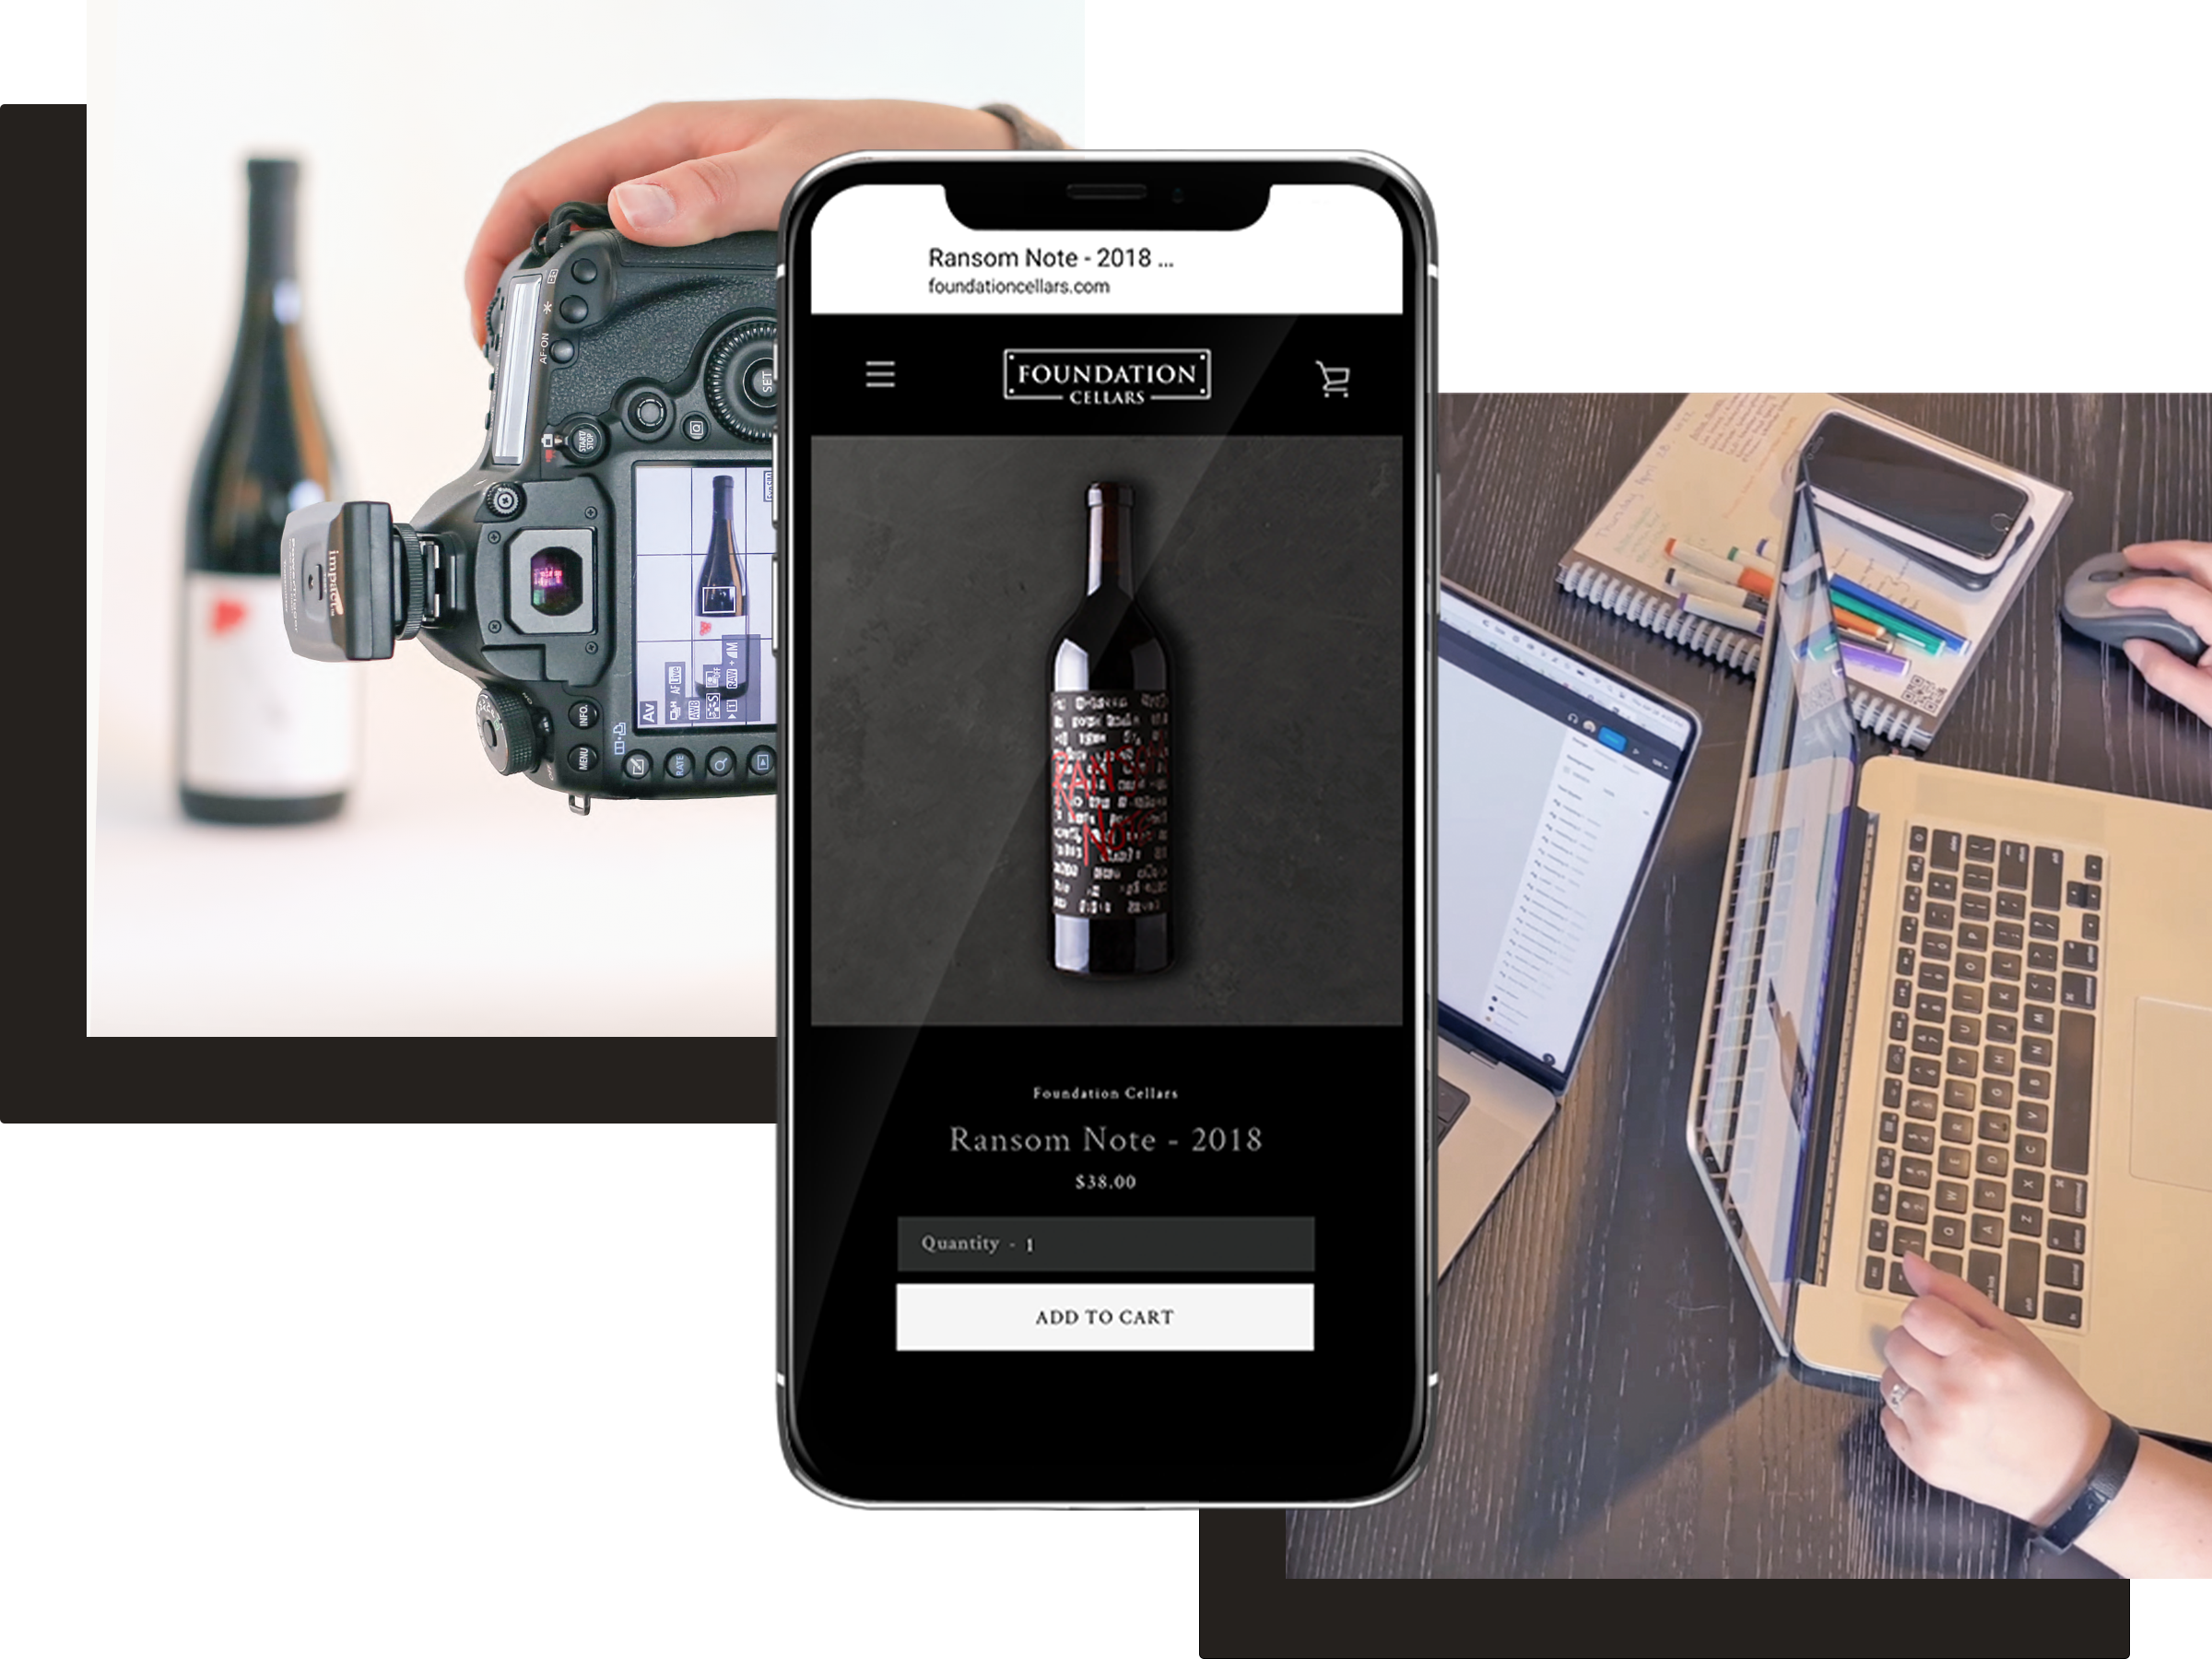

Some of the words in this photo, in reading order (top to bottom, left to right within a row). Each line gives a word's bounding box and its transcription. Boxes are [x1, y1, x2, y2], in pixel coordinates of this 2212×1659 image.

[929, 247, 1019, 268] Ransom
[1025, 247, 1078, 268] Note
[1097, 247, 1152, 268] 2018
[928, 277, 1111, 295] foundationcellars.com
[539, 333, 549, 364] AF-ON
[763, 371, 772, 393] SET
[1018, 364, 1195, 384] FOUNDATION
[1069, 391, 1145, 405] CELLARS
[579, 430, 587, 453] START/
[328, 550, 340, 608] impact
[670, 667, 680, 684] Live
[727, 669, 737, 688] RAW
[670, 685, 681, 695] AF
[579, 704, 589, 727] INFO.
[642, 703, 655, 723] Av
[689, 700, 700, 719] AWB
[579, 747, 589, 771] MENU
[676, 755, 684, 776] RATE
[1051, 728, 1170, 821] RANSOM
[1083, 803, 1159, 866] NOTE
[1033, 1087, 1120, 1100] Foundation
[1124, 1086, 1179, 1100] Cellars
[950, 1126, 1071, 1152] Ransom
[1084, 1126, 1157, 1152] Note
[1192, 1126, 1263, 1152] 2018
[1076, 1173, 1136, 1190] $38.00
[922, 1234, 1000, 1254] Quantity
[1026, 1238, 1034, 1253] 1
[1035, 1310, 1079, 1325] ADD
[1084, 1309, 1113, 1325] TO
[1118, 1309, 1174, 1325] CART
